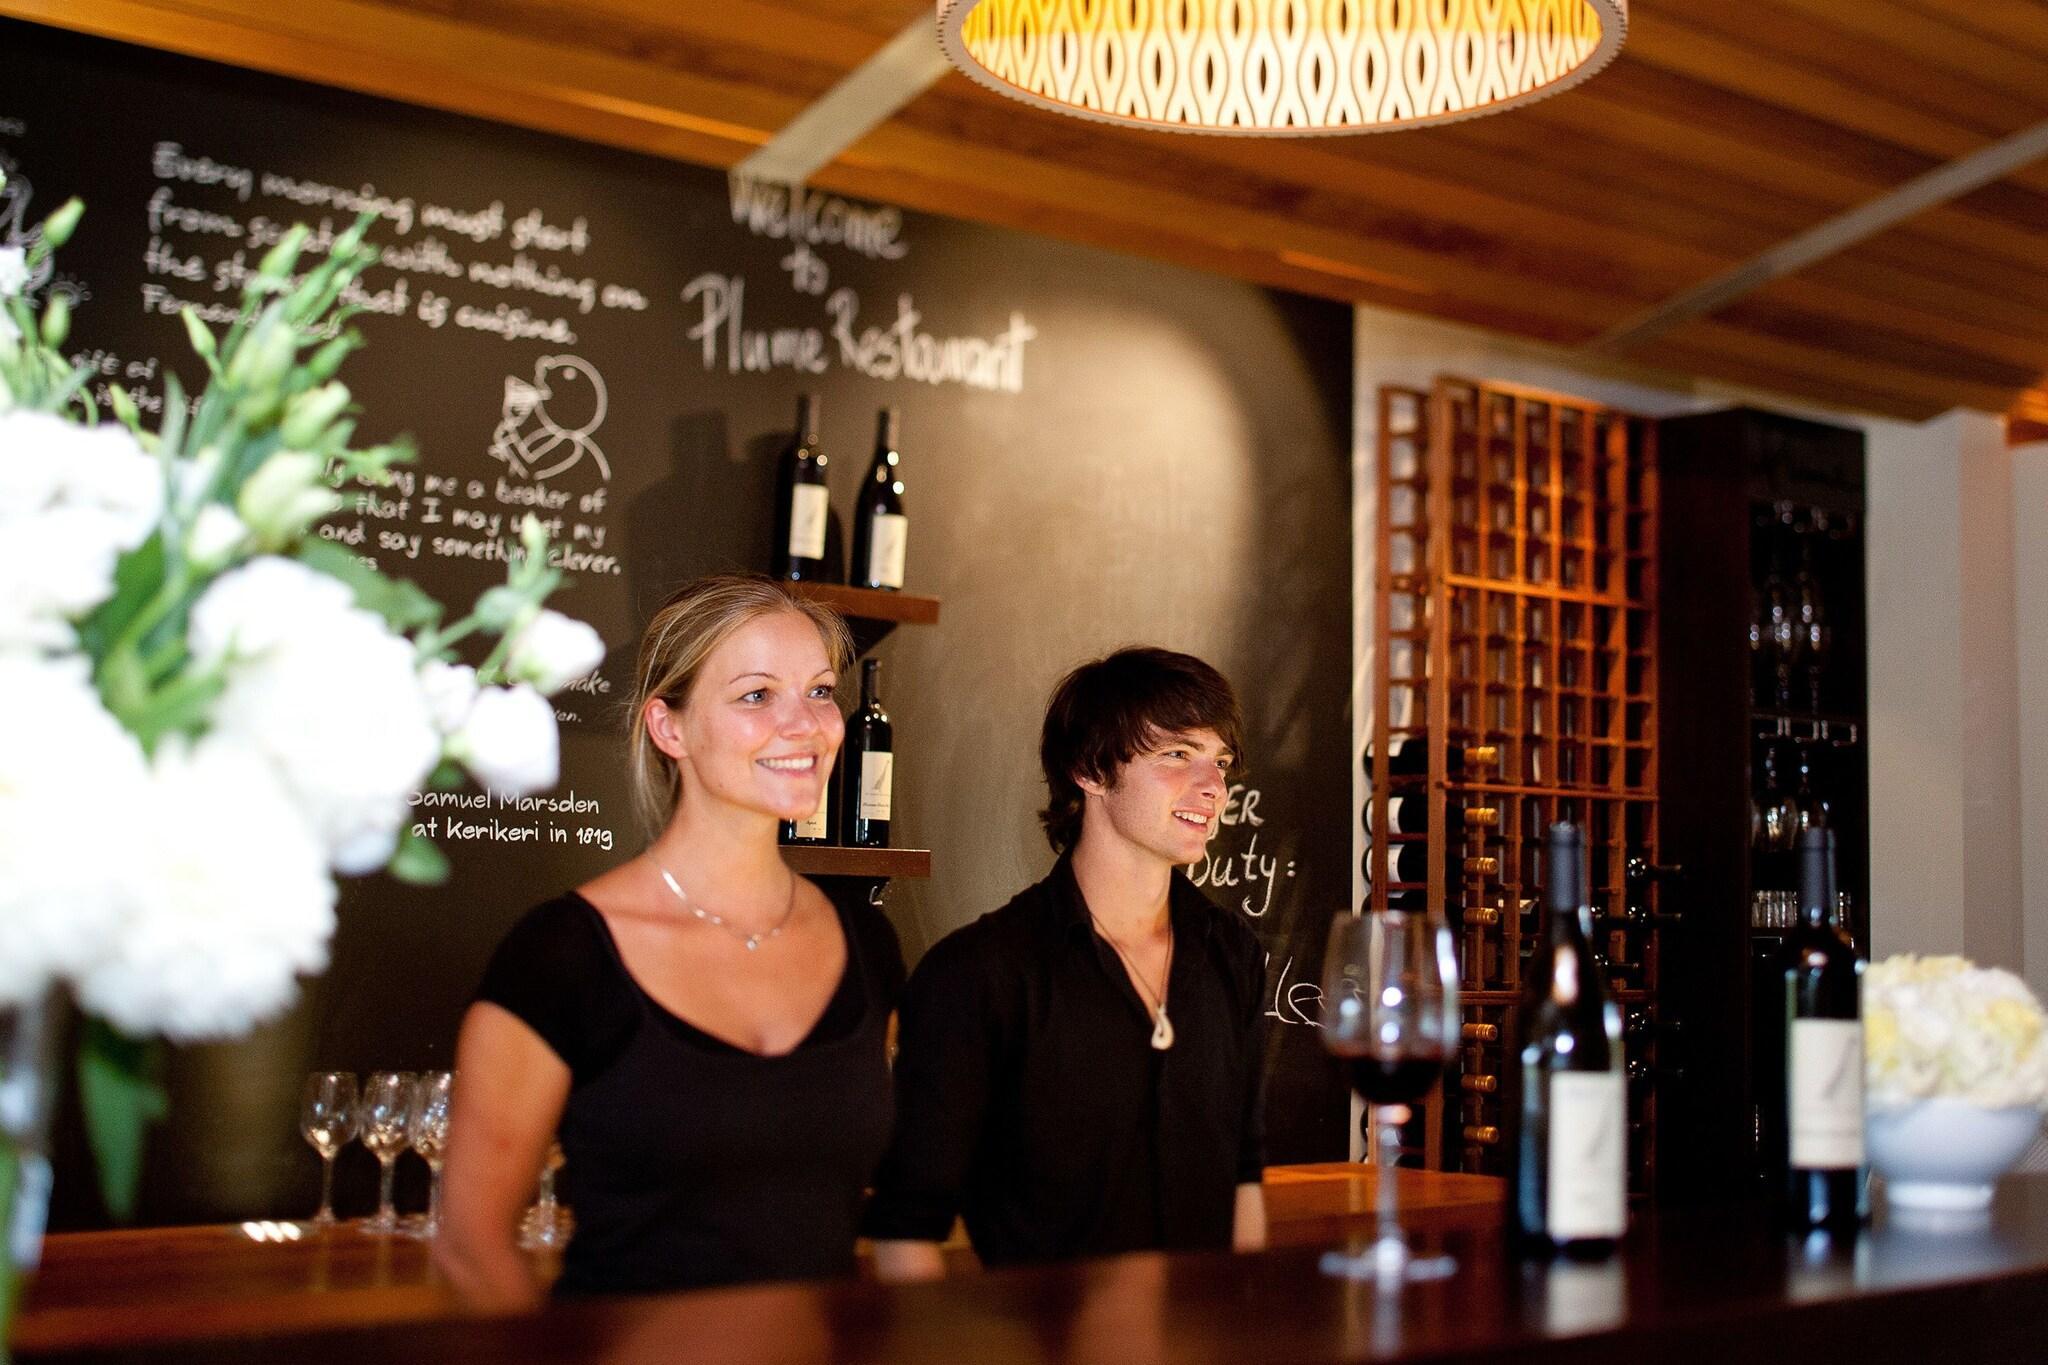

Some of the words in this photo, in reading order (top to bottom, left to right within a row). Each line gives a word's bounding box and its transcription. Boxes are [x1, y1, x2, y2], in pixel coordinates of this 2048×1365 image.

[781, 245, 830, 295] to
[680, 272, 829, 374] Plume
[319, 520, 367, 546] and
[378, 530, 423, 560] say
[499, 789, 600, 815] Marsden
[411, 816, 438, 838] at
[446, 815, 539, 842] Kerikeri
[549, 820, 568, 843] in
[576, 826, 614, 851] 1819
